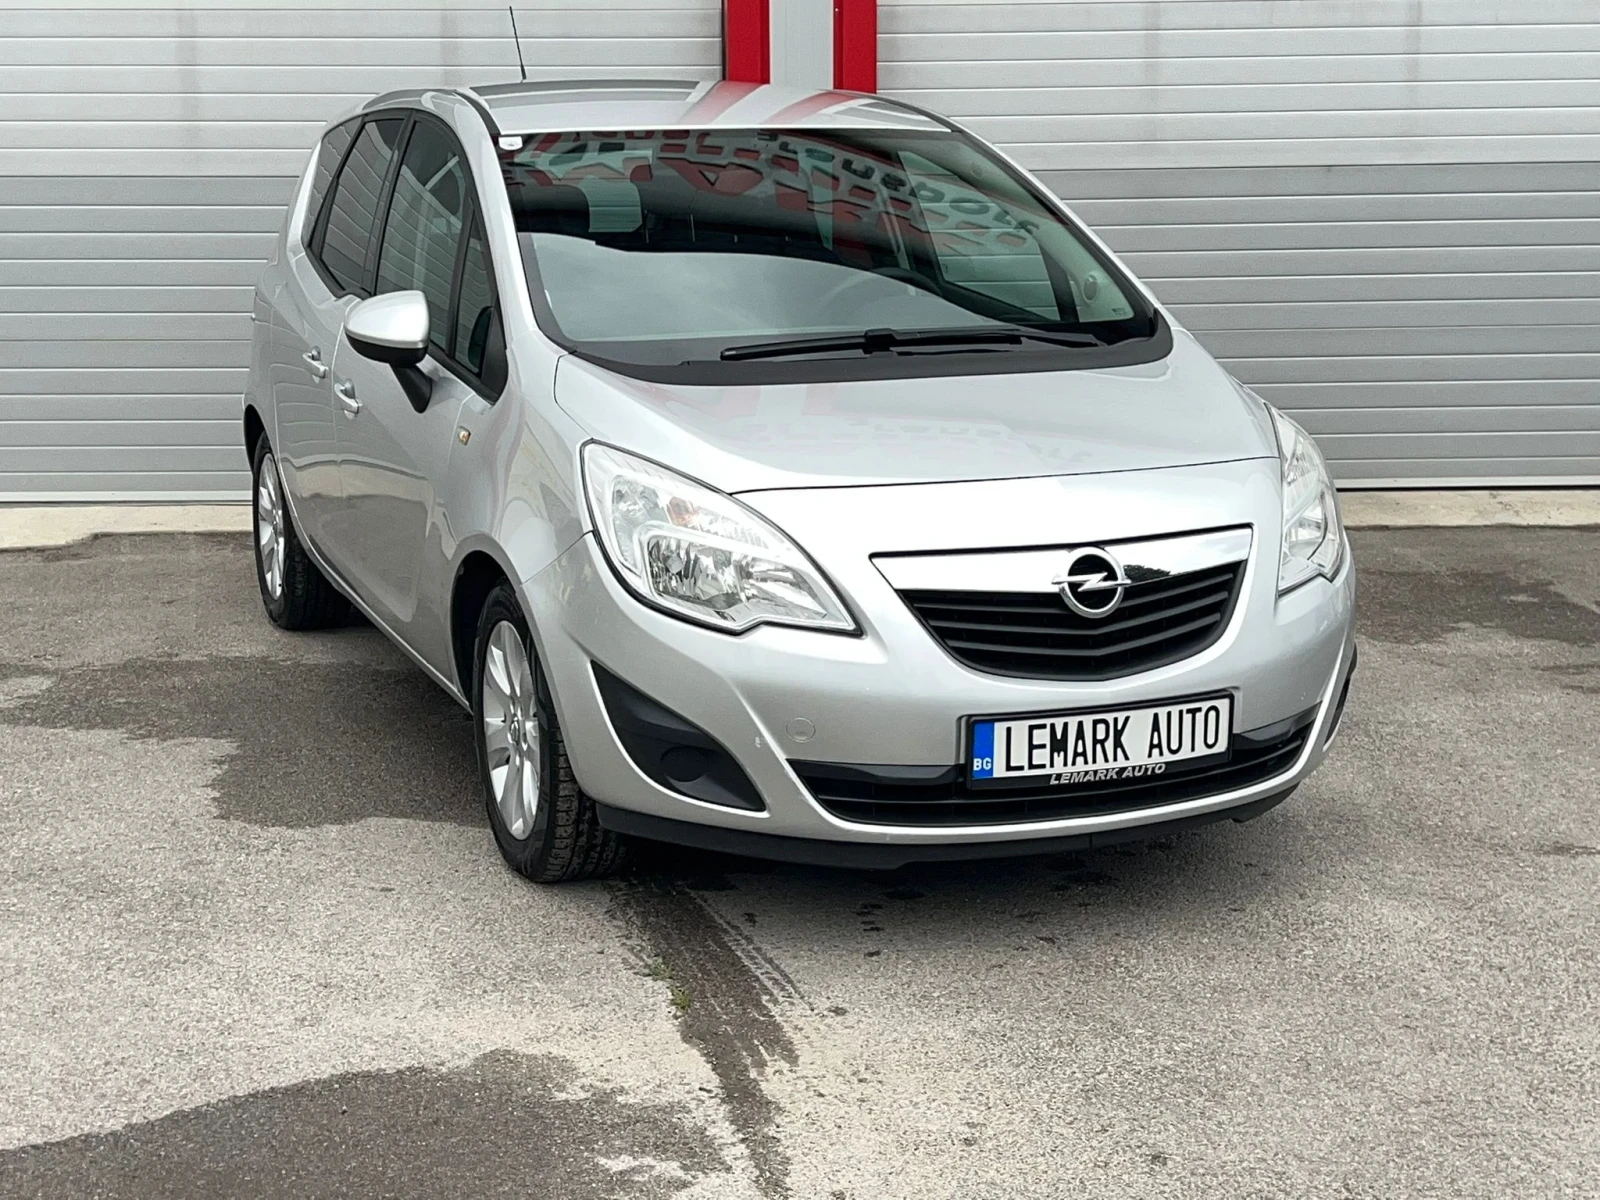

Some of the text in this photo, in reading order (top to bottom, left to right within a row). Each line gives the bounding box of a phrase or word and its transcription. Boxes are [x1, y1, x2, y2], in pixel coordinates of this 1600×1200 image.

[1005, 704, 1220, 772] LEMARK AUTO
[973, 757, 992, 771] BG
[1049, 763, 1166, 785] LEMARK AUTO
